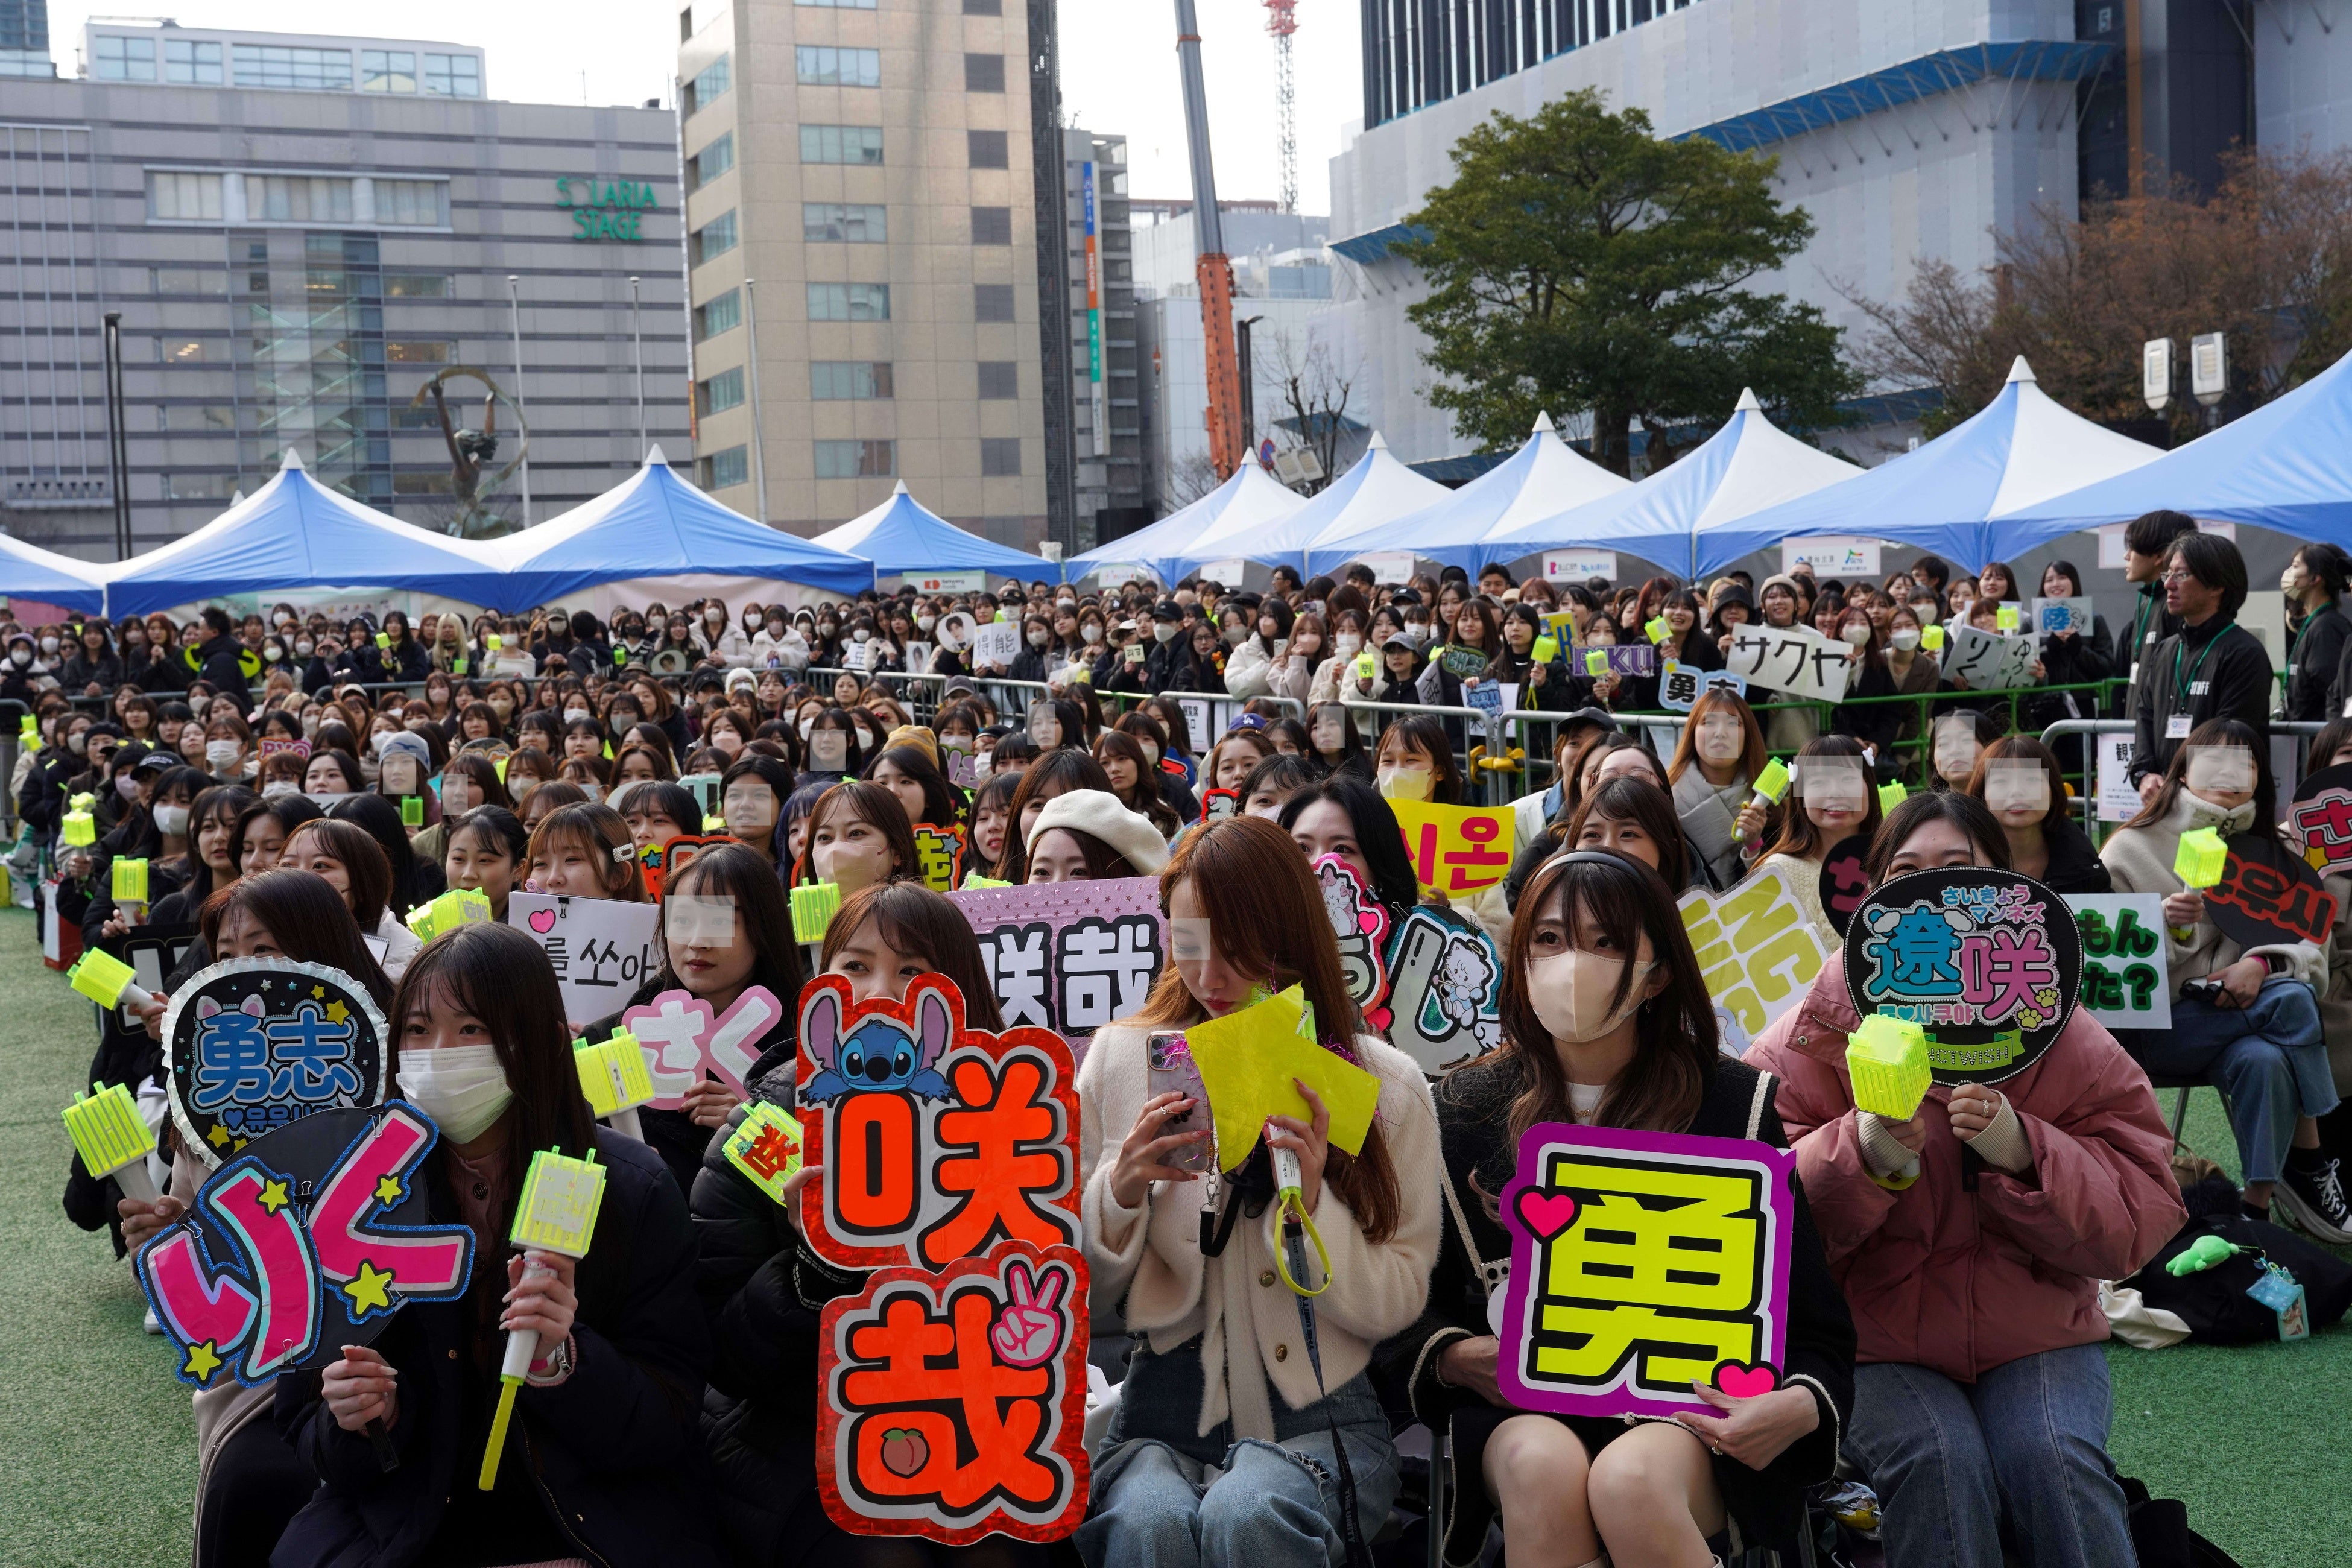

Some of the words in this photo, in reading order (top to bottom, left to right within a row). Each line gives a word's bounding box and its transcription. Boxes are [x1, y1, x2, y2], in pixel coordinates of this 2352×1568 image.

[556, 176, 659, 209] SOLARIA
[573, 209, 643, 240] STAGE
[976, 633, 1016, 656] 得能
[1574, 646, 1654, 676] RKU
[1735, 635, 1846, 688] サクヤ
[1243, 715, 1254, 724] LA
[1943, 886, 2031, 905] さいきょう
[1973, 906, 2046, 923] マンネズ
[197, 1008, 356, 1105] 勇志
[631, 998, 772, 1100] さく
[835, 1059, 1064, 1264] 咲
[151, 1113, 461, 1373] りく
[1536, 1162, 1756, 1386] 勇
[1301, 1295, 1312, 1327] UNITY
[1306, 1329, 1315, 1350] THE
[845, 1293, 1058, 1508] 哉
[1345, 1511, 1355, 1543] UNITY
